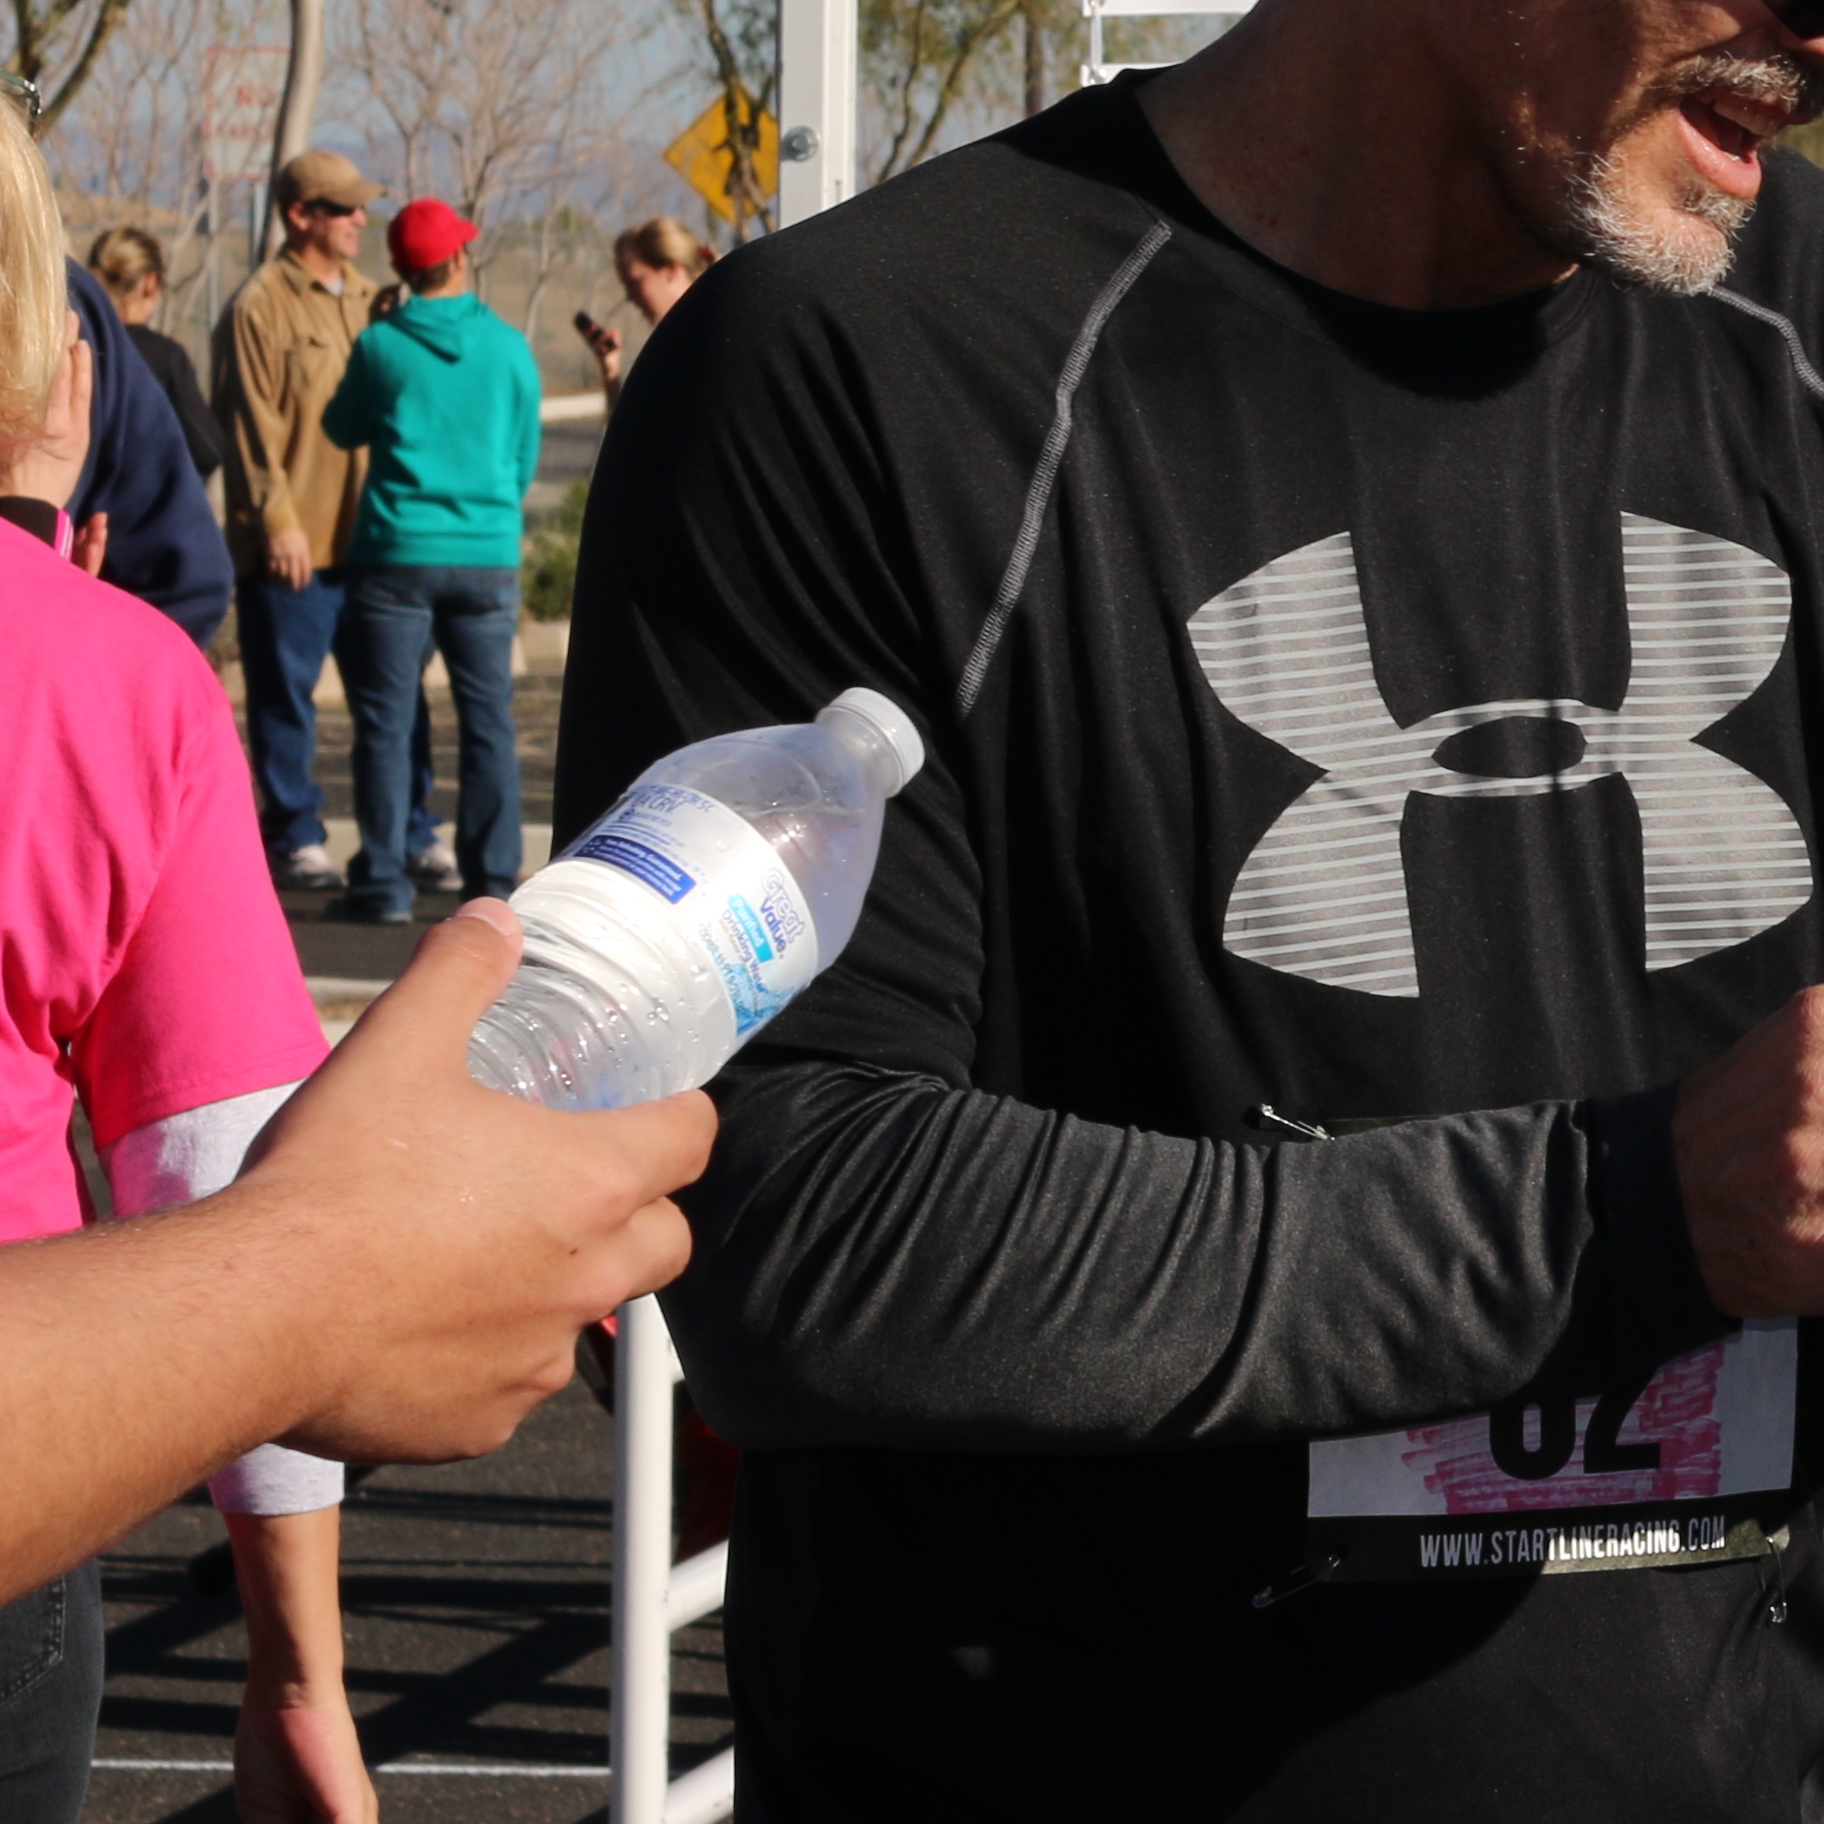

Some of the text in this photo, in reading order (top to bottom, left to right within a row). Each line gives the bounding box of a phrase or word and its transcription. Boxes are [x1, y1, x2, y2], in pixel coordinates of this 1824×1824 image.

[760, 897, 787, 953] Value
[761, 869, 805, 944] Great
[1420, 1516, 1726, 1568] WWW.STARTLINERACING.COM
